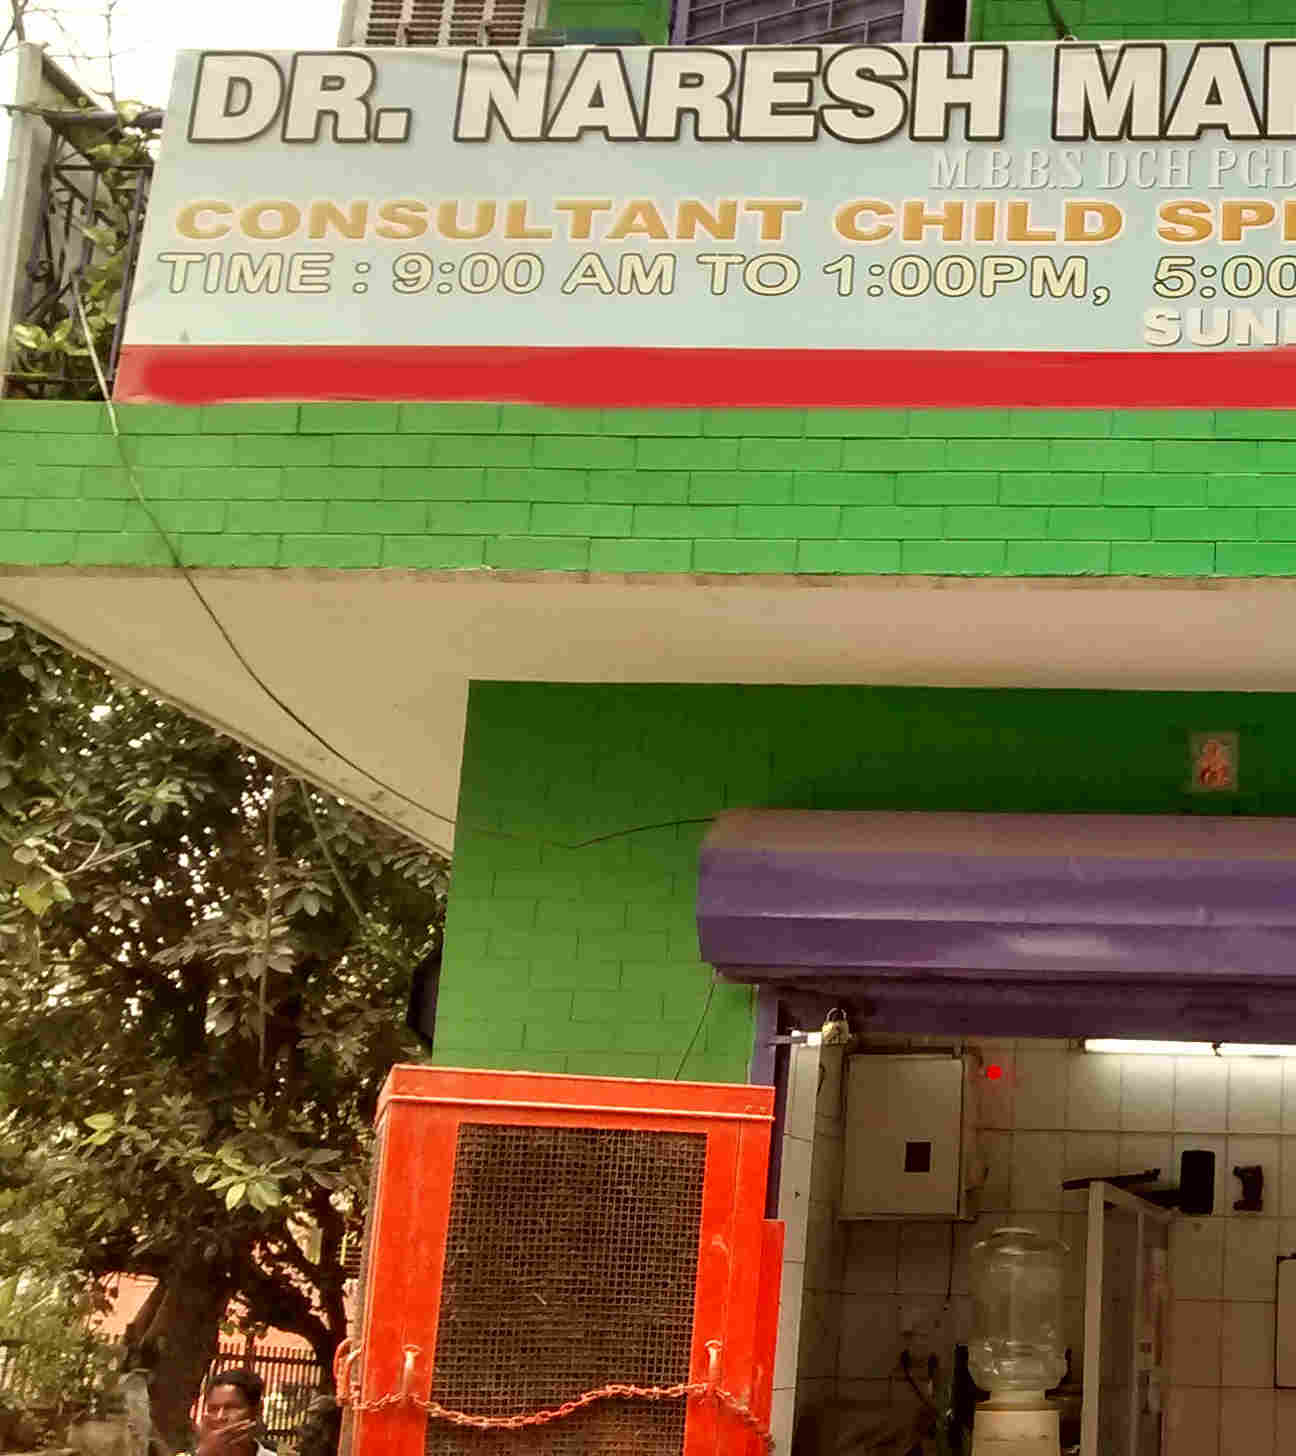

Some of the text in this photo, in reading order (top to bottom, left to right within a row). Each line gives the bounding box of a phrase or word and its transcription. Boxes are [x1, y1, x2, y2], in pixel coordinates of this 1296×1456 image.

[188, 50, 411, 144] DR.
[453, 44, 1008, 143] NARESH
[1098, 146, 1194, 190] DCH
[174, 197, 803, 242] CONSULTANT
[833, 198, 1125, 243] CHILD
[157, 252, 334, 296] TIME
[391, 252, 545, 297] 9:00
[560, 252, 676, 297] AM
[696, 253, 801, 298] TO
[822, 254, 1112, 307] 1:00PM,
